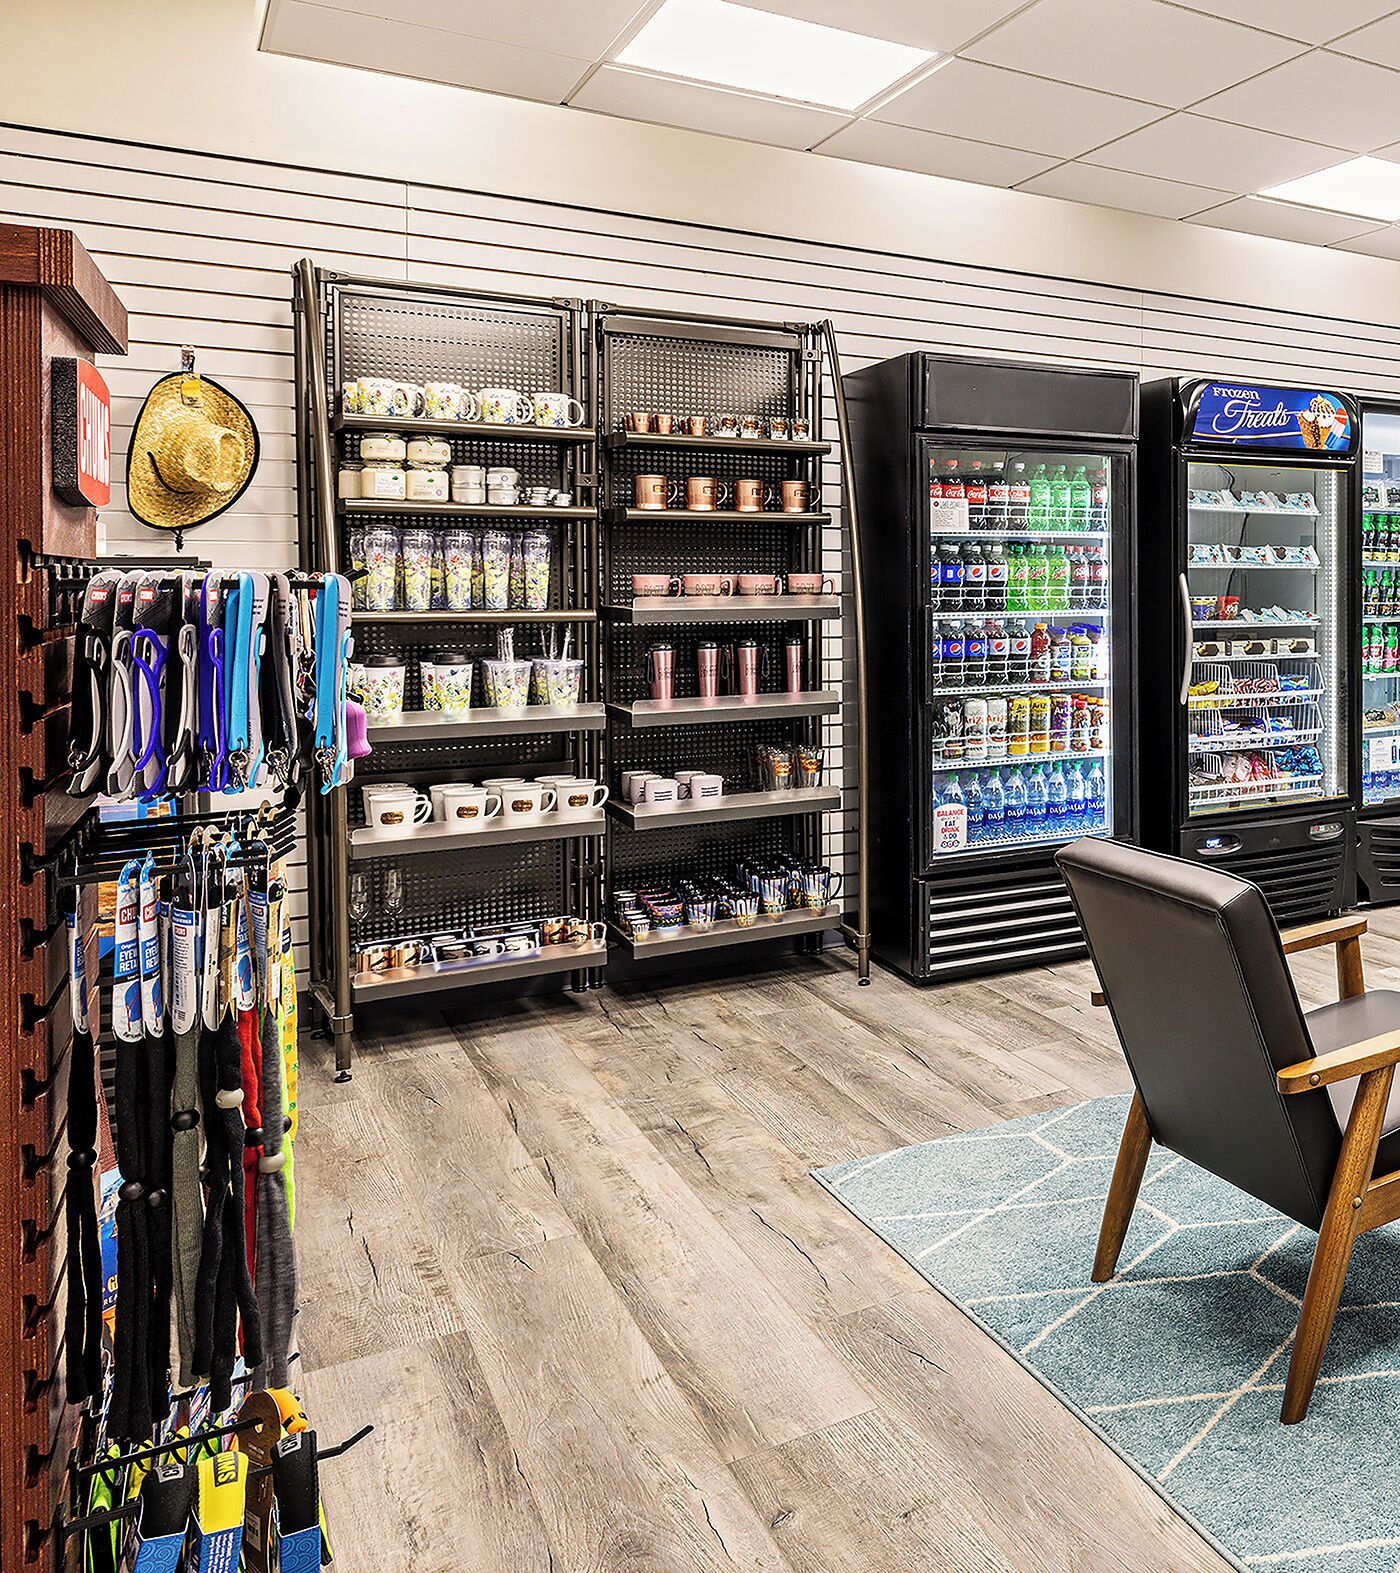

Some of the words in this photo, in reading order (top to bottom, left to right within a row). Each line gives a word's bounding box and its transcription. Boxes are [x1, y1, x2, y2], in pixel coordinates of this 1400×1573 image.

[1212, 386, 1261, 400] Frozen
[1212, 399, 1293, 434] Treats
[80, 381, 109, 487] CHUMS
[936, 808, 965, 818] BALANCE
[944, 819, 957, 828] EAT
[940, 826, 960, 834] DRINK
